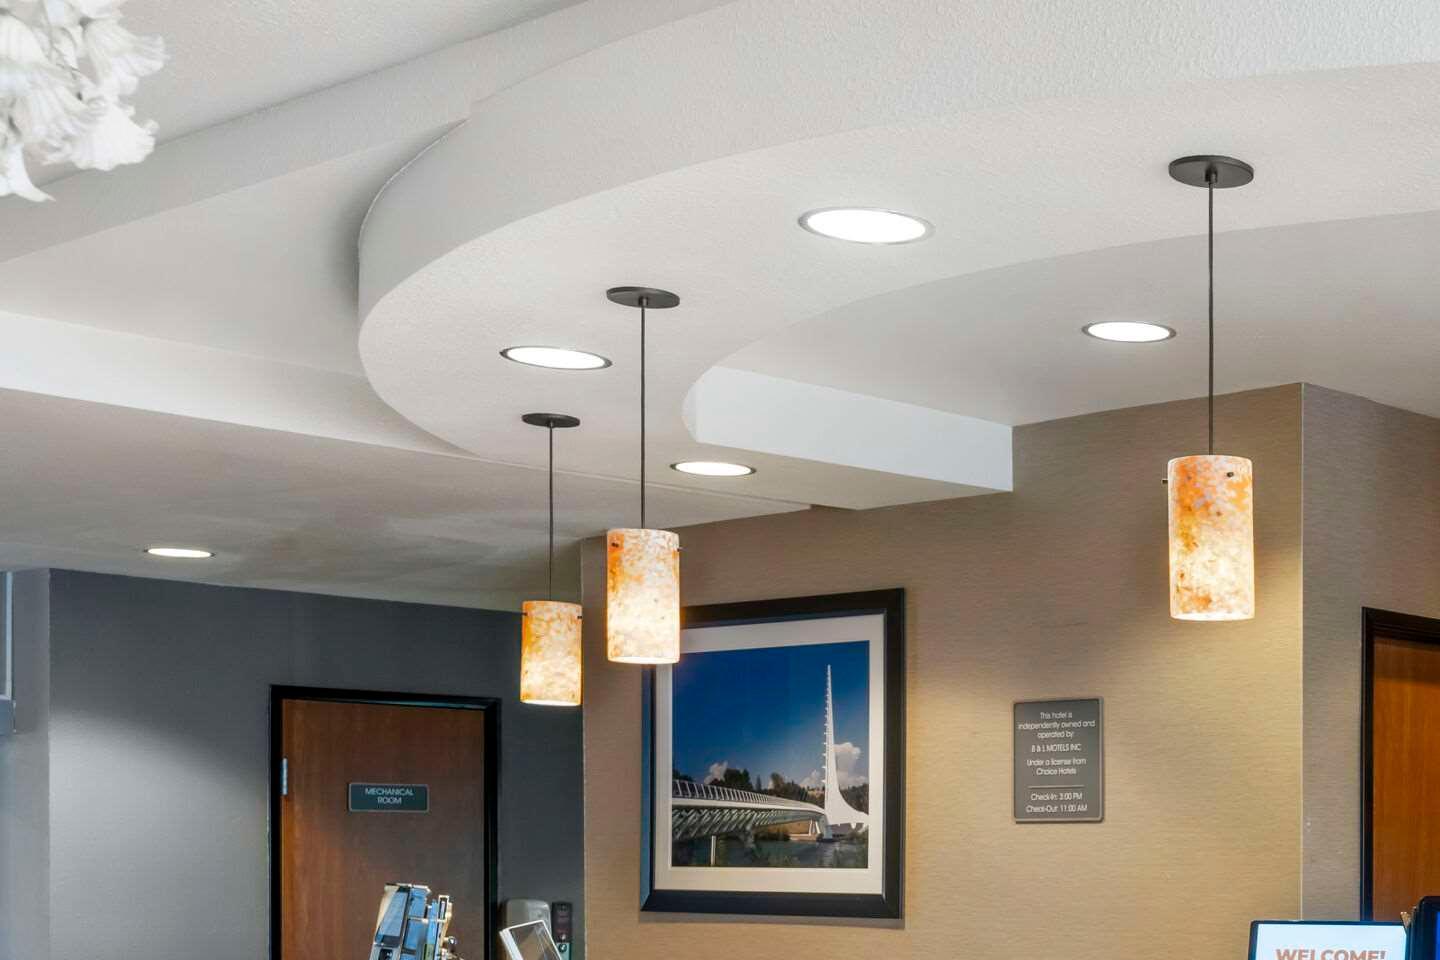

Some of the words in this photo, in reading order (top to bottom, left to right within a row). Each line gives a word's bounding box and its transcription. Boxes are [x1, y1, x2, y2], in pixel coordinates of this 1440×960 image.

[1018, 721, 1060, 730] independently
[1061, 720, 1082, 728] owned
[1037, 730, 1065, 738] operated
[365, 787, 414, 796] MECHANICAL
